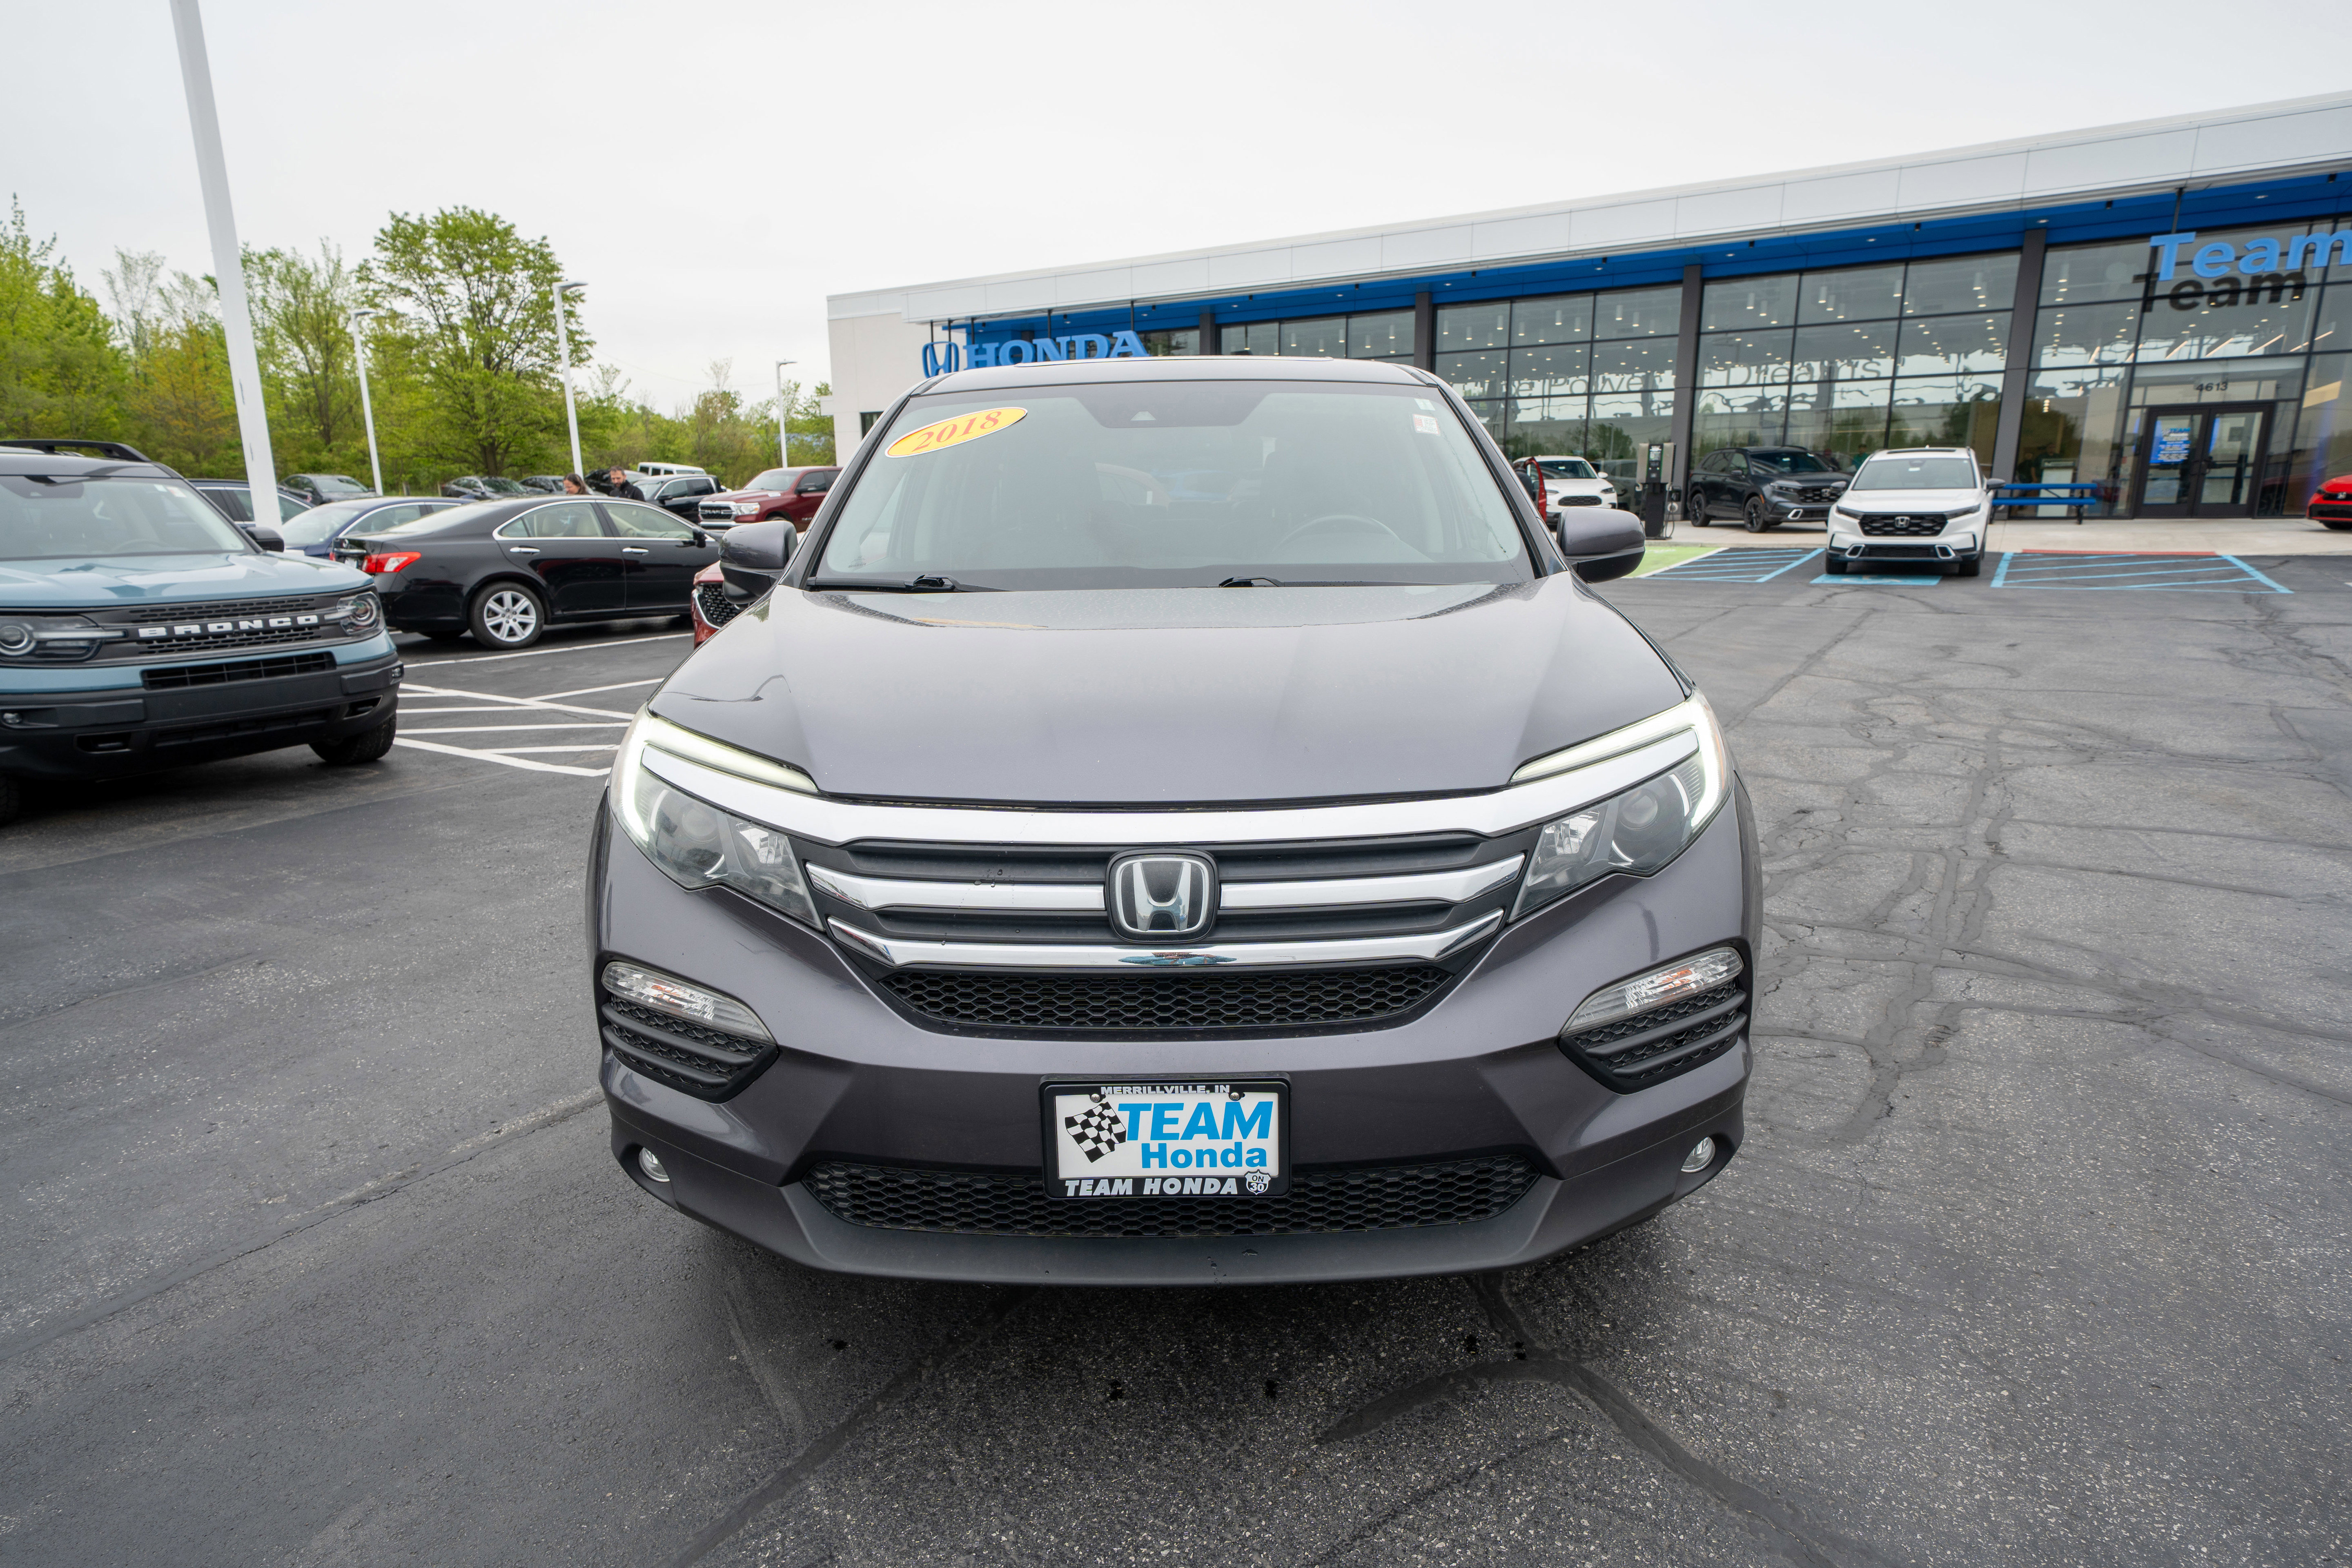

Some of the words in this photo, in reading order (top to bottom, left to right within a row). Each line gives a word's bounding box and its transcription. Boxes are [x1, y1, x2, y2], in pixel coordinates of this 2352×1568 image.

[2150, 229, 2352, 281] Team
[963, 330, 1152, 370] HONDA
[2196, 382, 2228, 392] 4613
[911, 411, 1002, 452] 2018
[138, 615, 318, 637] BRONCO
[1101, 1085, 1210, 1094] MERRILLVILLE,
[1214, 1085, 1229, 1093] IN
[1118, 1101, 1273, 1141] TEAM
[1141, 1142, 1267, 1169] Honda
[1065, 1178, 1133, 1196] TEAM
[1143, 1178, 1238, 1195] HONDA
[1250, 1183, 1264, 1191] 30
